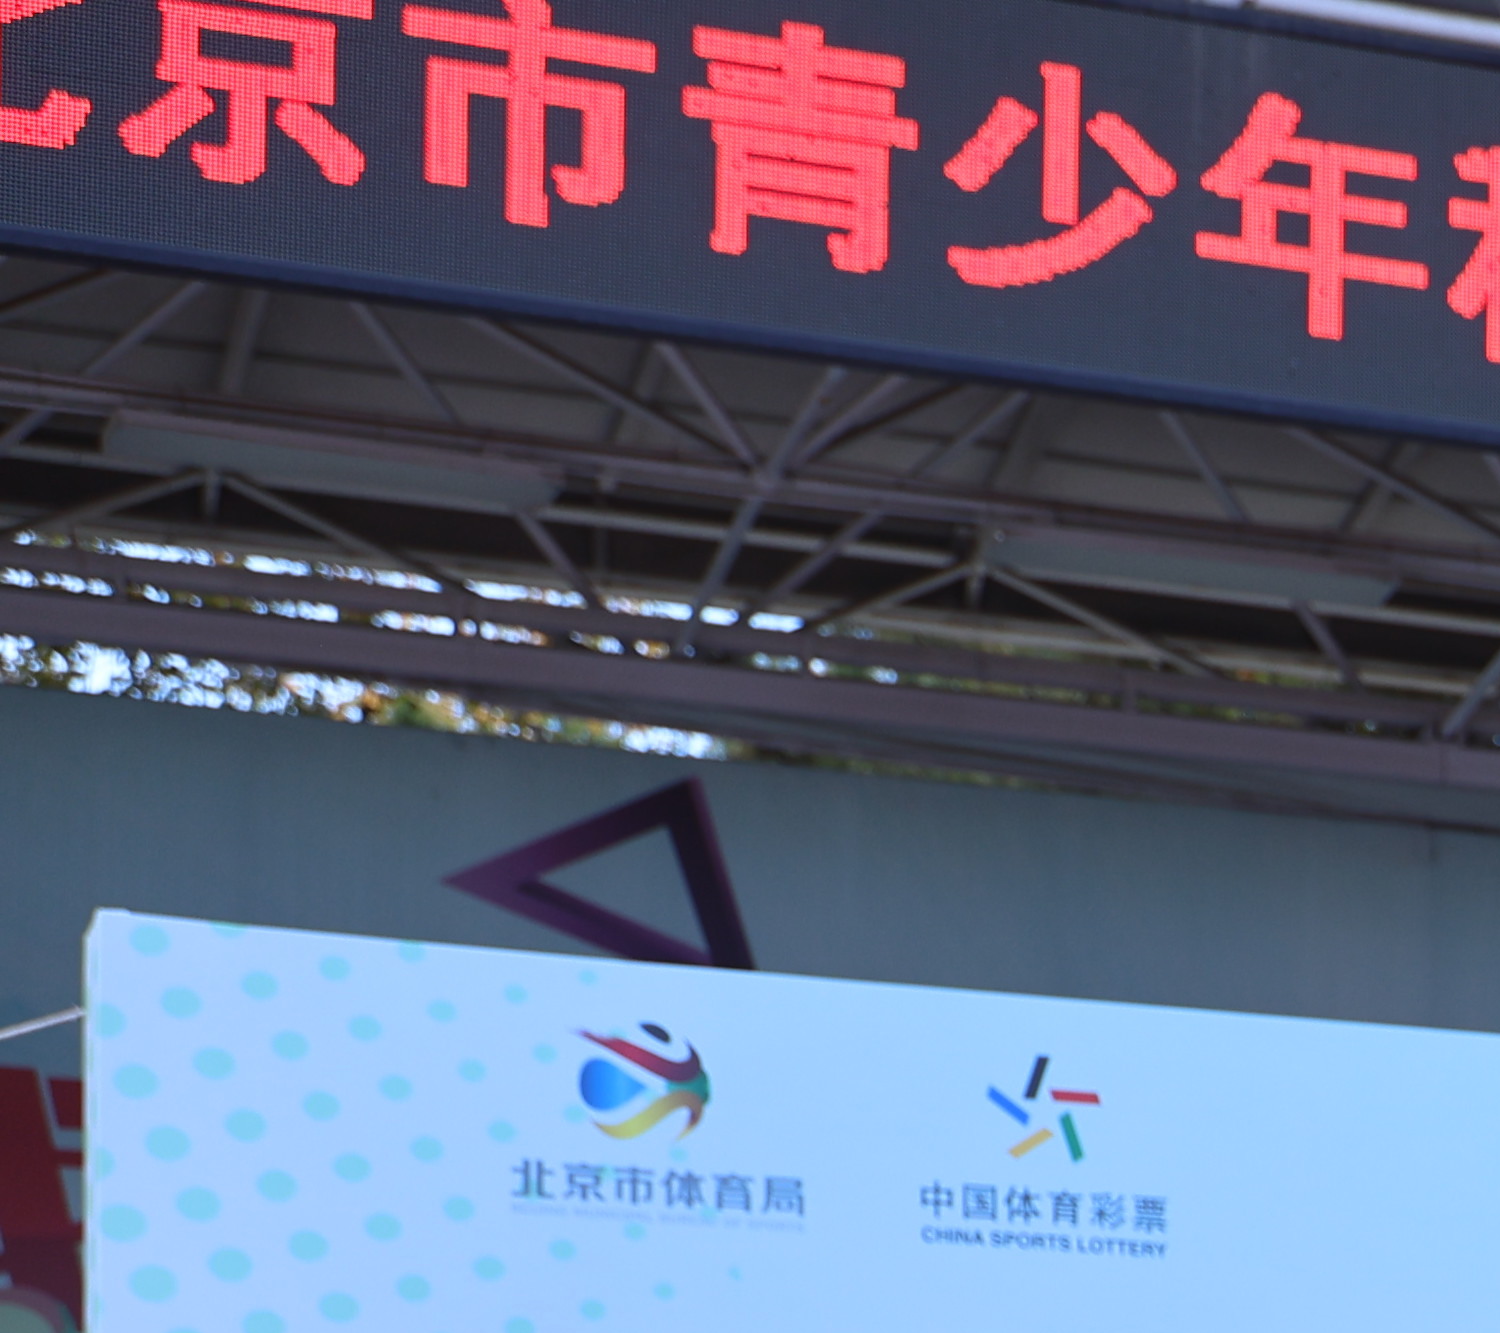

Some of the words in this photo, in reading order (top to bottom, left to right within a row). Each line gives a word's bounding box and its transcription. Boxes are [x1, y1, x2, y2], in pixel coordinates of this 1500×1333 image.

[511, 1158, 805, 1217] 北京市体育局
[919, 1180, 1169, 1234] 中国体育彩票
[920, 1225, 985, 1246] CHINA
[989, 1229, 1071, 1251] SPORTS
[1076, 1236, 1167, 1258] LOTTERY
